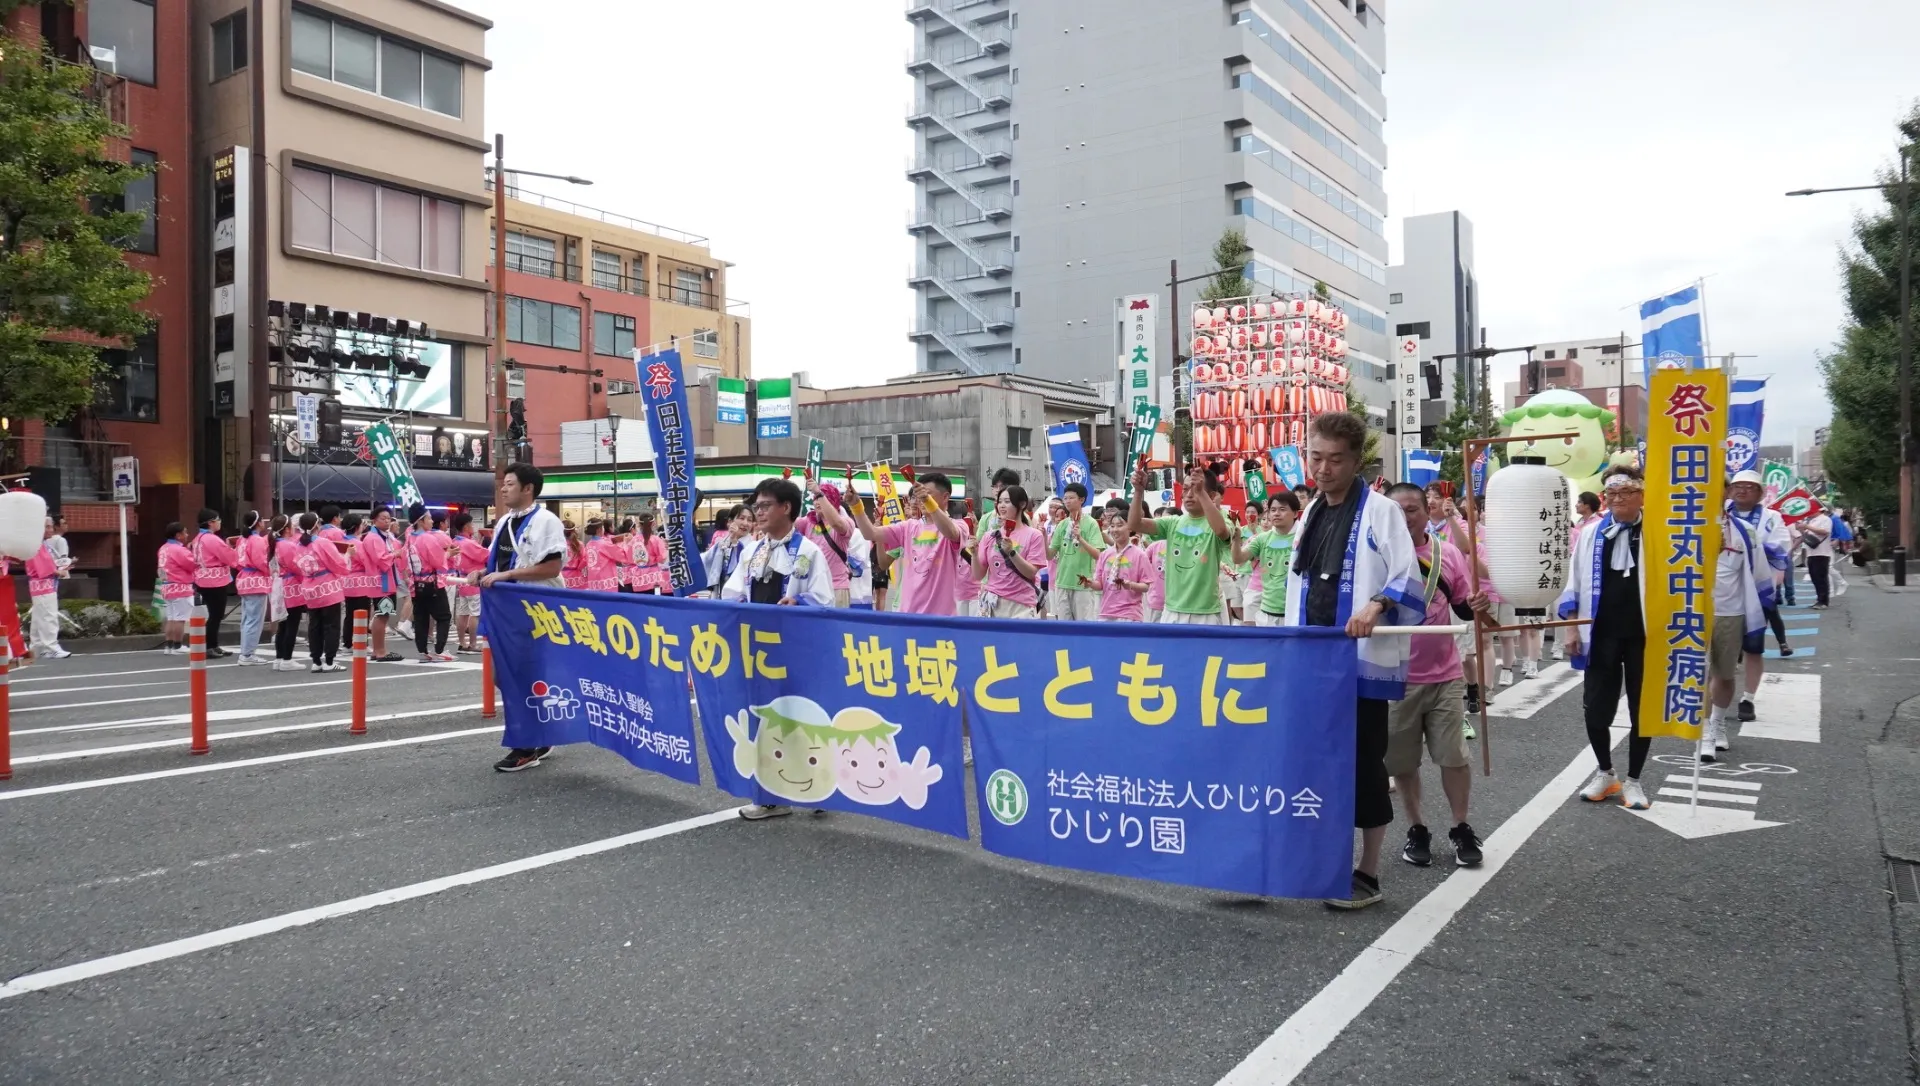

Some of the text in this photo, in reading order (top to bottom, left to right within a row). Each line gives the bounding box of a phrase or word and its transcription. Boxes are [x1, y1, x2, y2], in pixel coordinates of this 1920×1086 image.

[1135, 314, 1145, 341] 焼肉の
[645, 361, 677, 399] 祭
[1405, 373, 1416, 425] 日本生命
[758, 403, 791, 413] FamilyMart
[761, 424, 789, 437] 酒 たばこ
[1664, 382, 1716, 438] 祭
[597, 481, 633, 491] FamilMart
[1537, 508, 1553, 589] かっぱつ会
[1551, 491, 1562, 589] 田主丸中央病院
[1663, 444, 1711, 727] 田主丸中央病院
[520, 599, 1268, 728] 地域のために 地域とともに
[578, 677, 653, 724] 医療法人聖峰会
[585, 702, 692, 765] 田主丸中央病院
[1047, 769, 1323, 820] 社会福祉法人ひじり会
[1049, 807, 1186, 855] ひじり園
